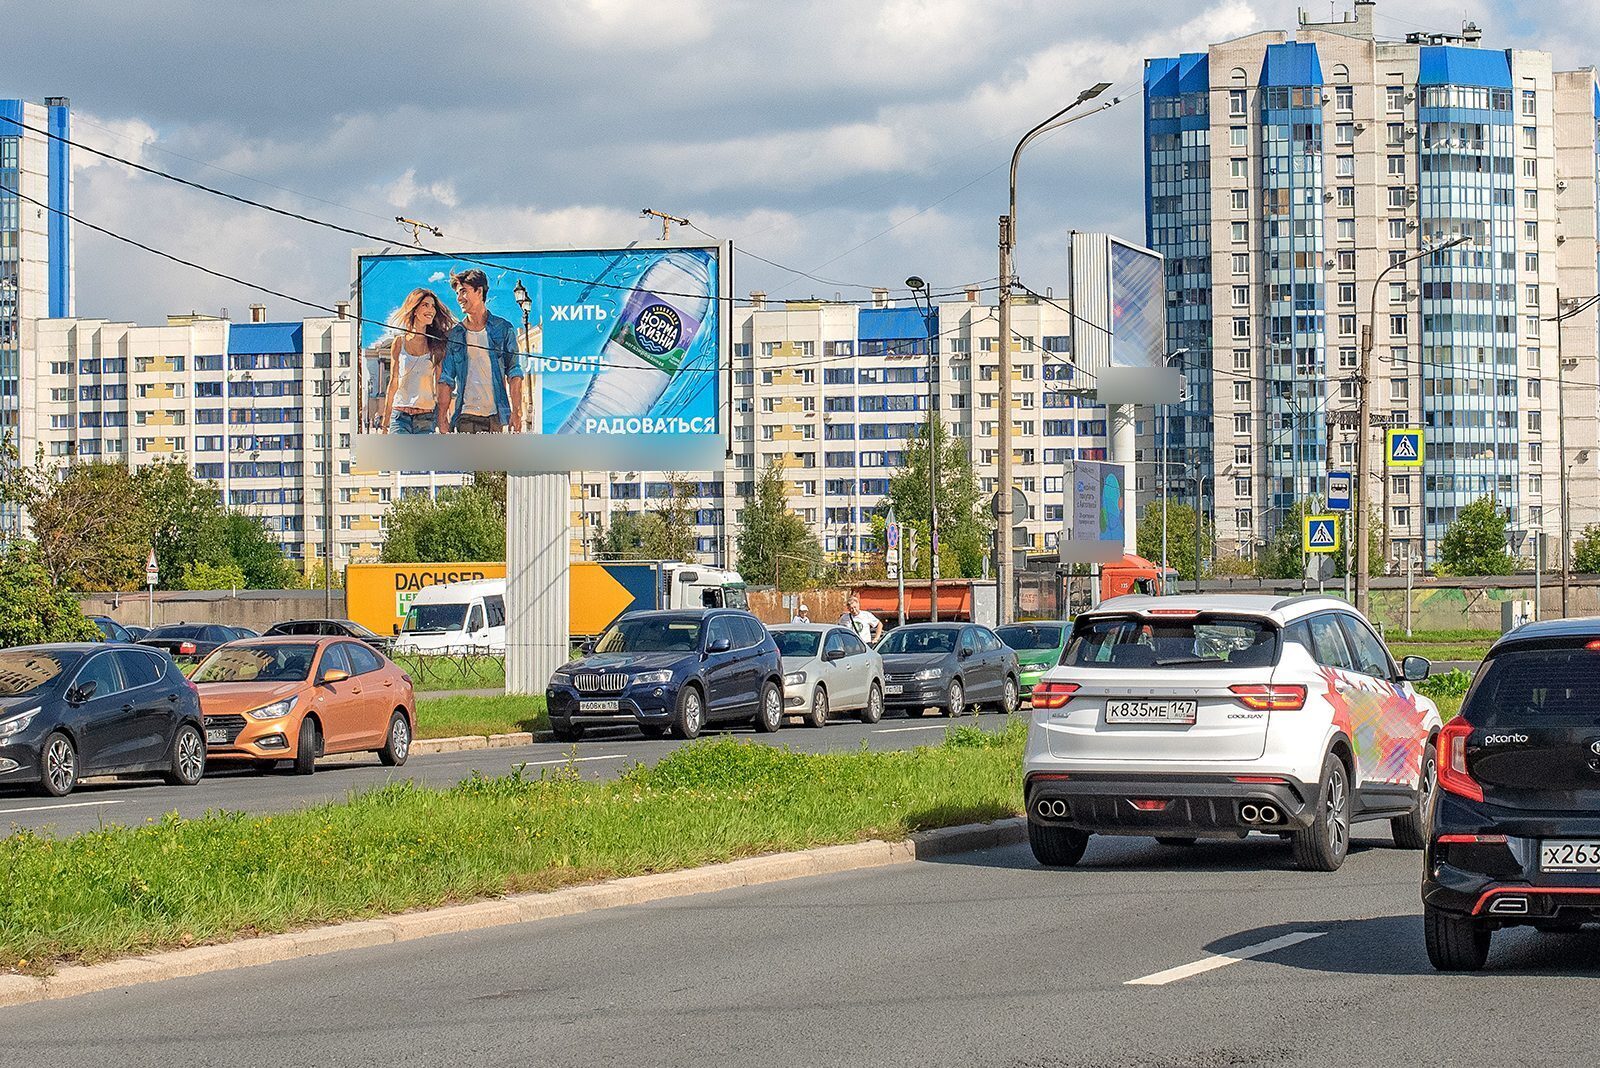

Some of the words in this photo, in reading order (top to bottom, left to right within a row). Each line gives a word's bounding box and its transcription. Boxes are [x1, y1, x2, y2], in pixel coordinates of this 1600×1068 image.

[550, 304, 607, 321] ЖИТЬ
[641, 310, 679, 340] НОРМА
[635, 320, 675, 351] ЖИЗНИ
[525, 355, 609, 372] ЛЮБИТЬ
[585, 416, 716, 435] РАДОВАТЬСЯ
[1111, 702, 1167, 717] К835МЕ
[1170, 702, 1192, 713] 147
[1484, 733, 1529, 746] picanto
